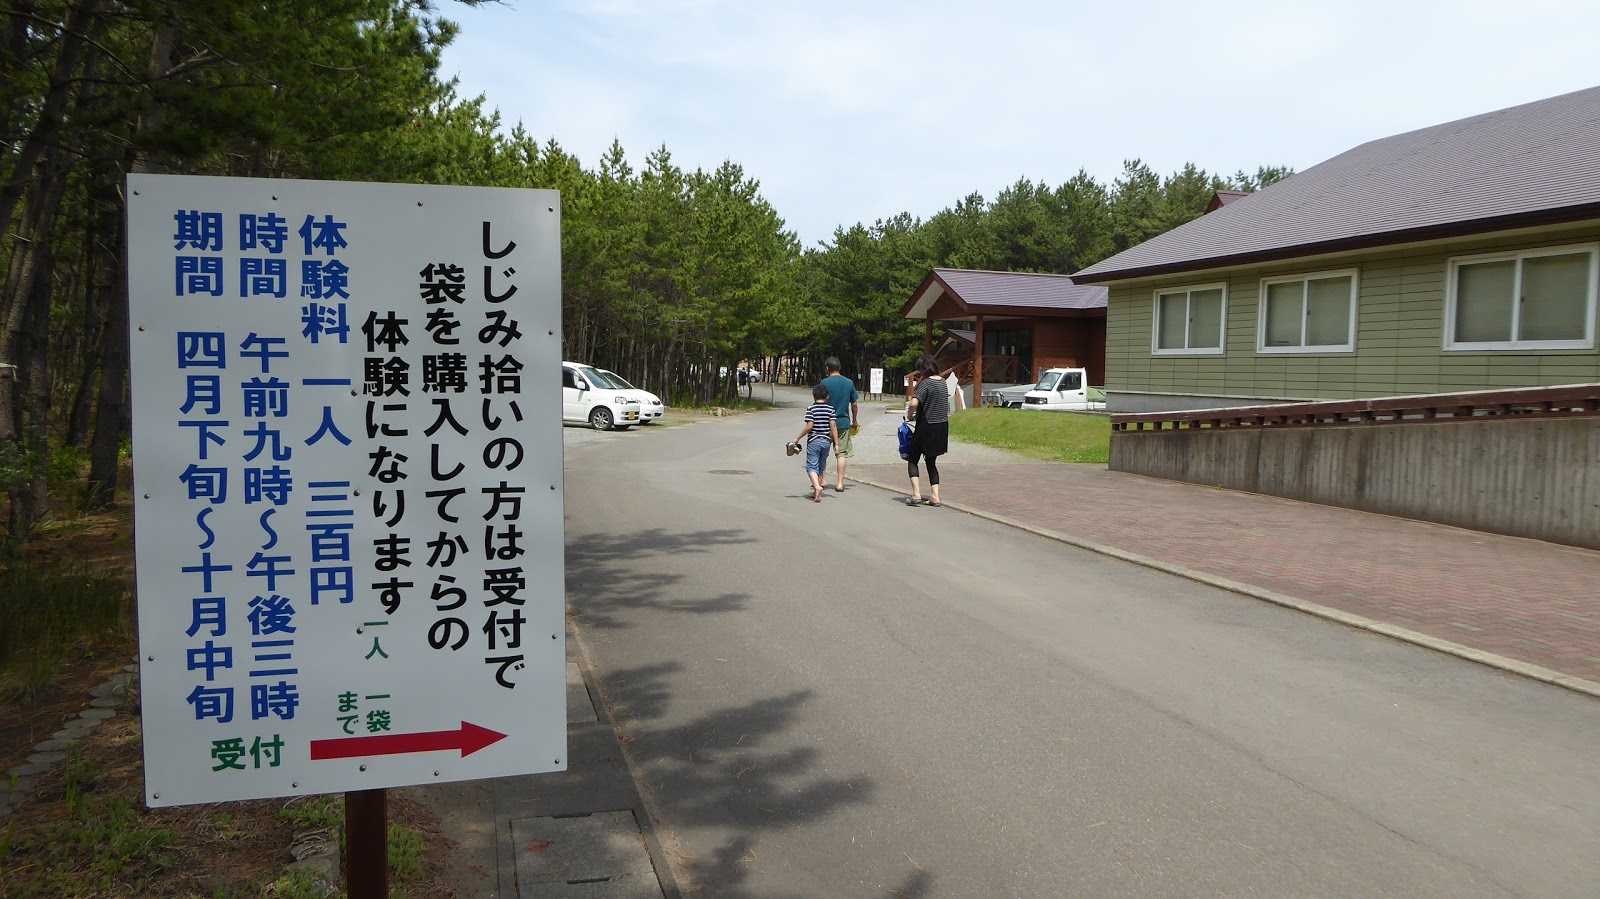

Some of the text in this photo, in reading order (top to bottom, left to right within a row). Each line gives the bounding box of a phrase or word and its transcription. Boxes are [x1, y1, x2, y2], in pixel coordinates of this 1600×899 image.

[173, 208, 225, 297] 期間
[239, 211, 289, 299] 時間
[298, 214, 354, 606] 体験料 一人 三百円
[361, 310, 414, 615] 体験になります
[419, 262, 470, 652] 袋を購入してからの
[479, 221, 526, 689] しじみ拾いの方は受付で
[336, 691, 359, 735] まで
[364, 621, 391, 733] 一人 一袋
[211, 734, 285, 772] 受付
